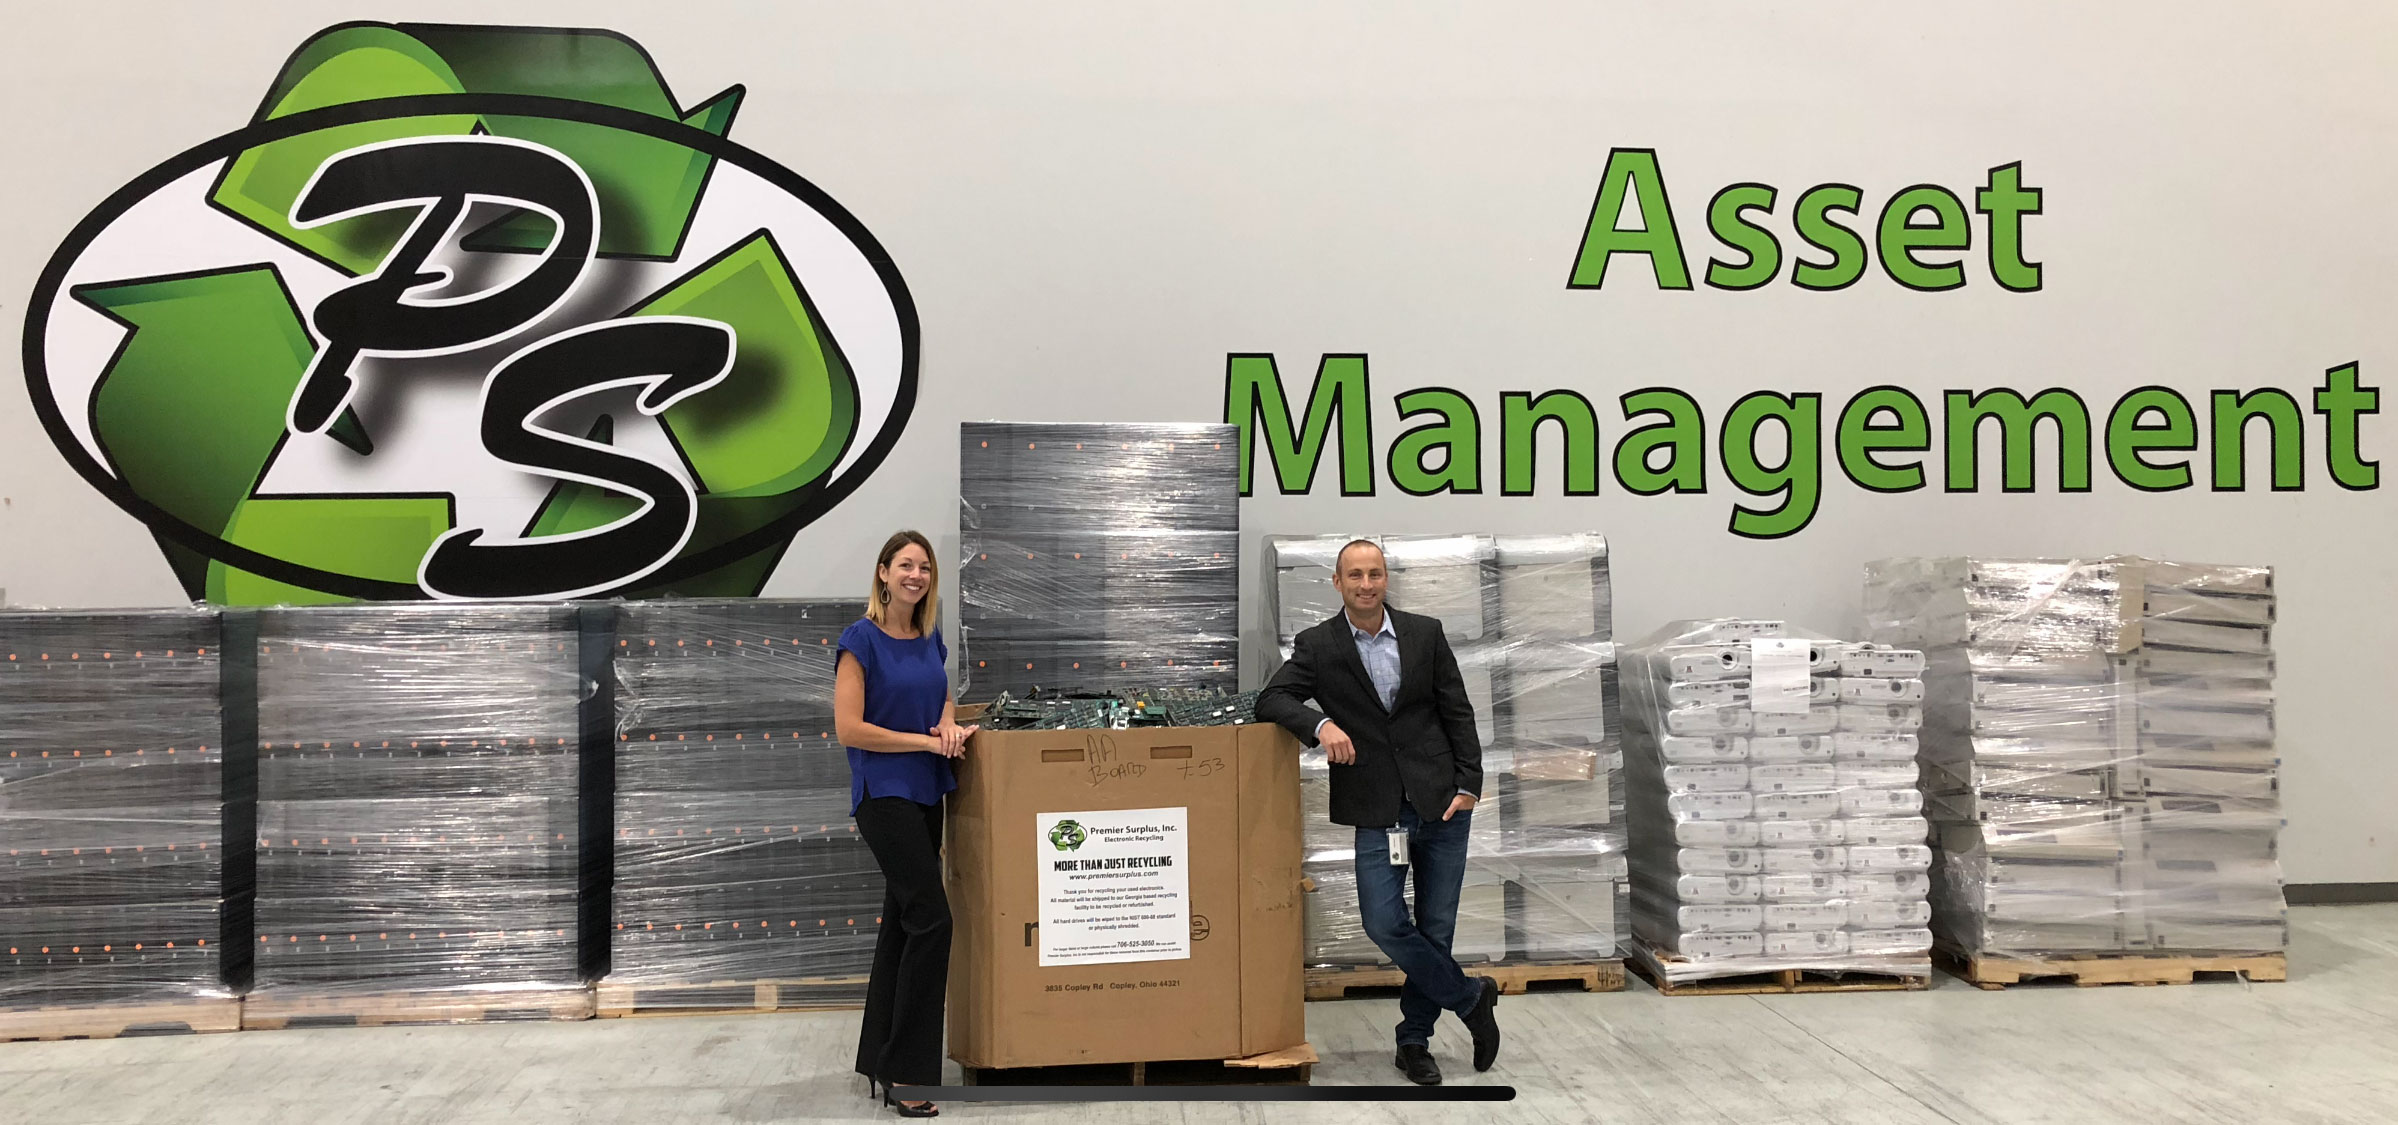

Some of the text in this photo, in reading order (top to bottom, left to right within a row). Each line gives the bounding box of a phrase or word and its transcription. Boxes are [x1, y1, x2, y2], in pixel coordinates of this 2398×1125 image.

[1567, 147, 2043, 293] Asset
[1223, 351, 2380, 539] Management
[1086, 734, 1117, 765] AA
[1088, 763, 1147, 787] BOARD
[1090, 824, 1178, 835] Premier Surplus, Inc.
[1054, 856, 1172, 871] MORE THAN JUST RECYCLING
[1069, 871, 1158, 880] www.premiersurplus.com
[1117, 940, 1154, 948] 706-525-3050
[1065, 984, 1090, 992] Copley
